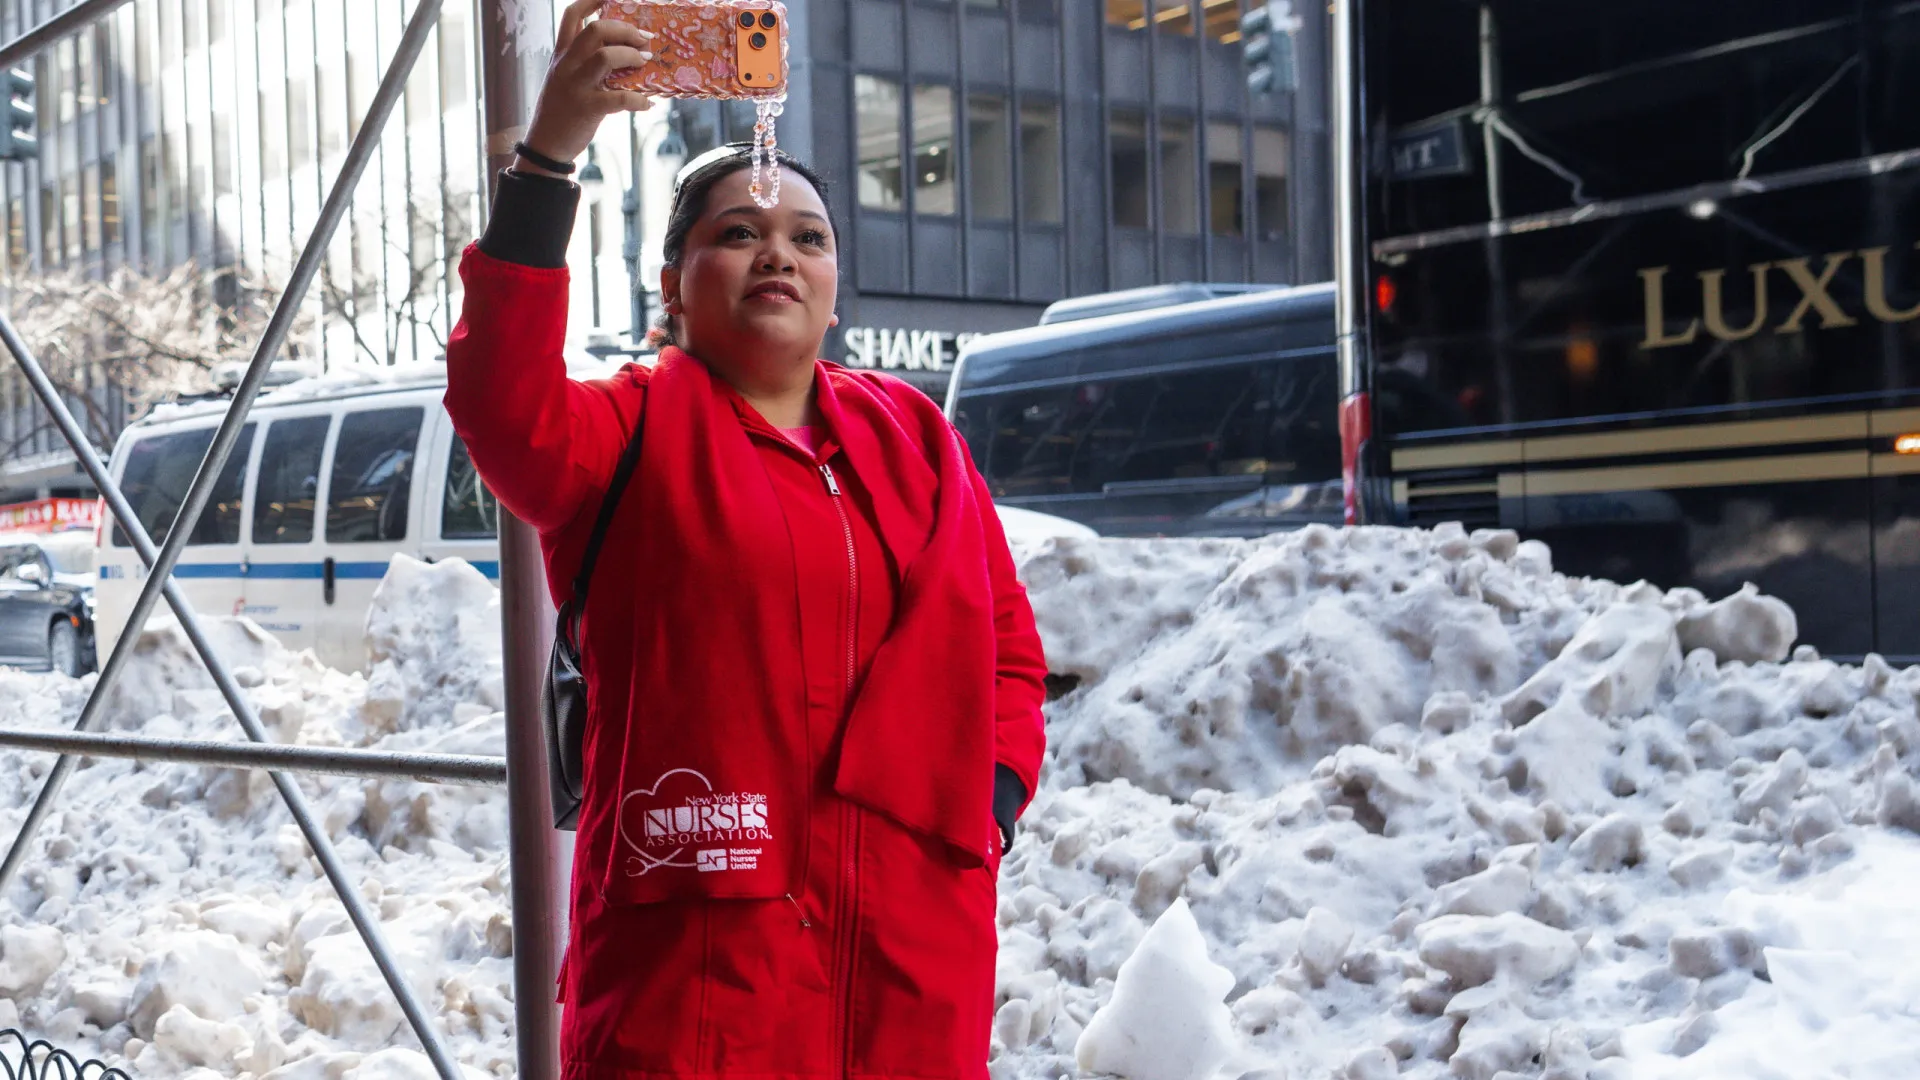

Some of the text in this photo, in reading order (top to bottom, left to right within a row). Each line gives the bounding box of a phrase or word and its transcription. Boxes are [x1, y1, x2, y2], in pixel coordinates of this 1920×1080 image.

[1636, 244, 1920, 350] LUXU
[844, 326, 954, 372] SHAKE
[685, 791, 767, 806] New York State
[644, 802, 768, 837] NURSES
[729, 847, 763, 856] National
[730, 855, 758, 863] Nurses
[730, 862, 758, 870] United
